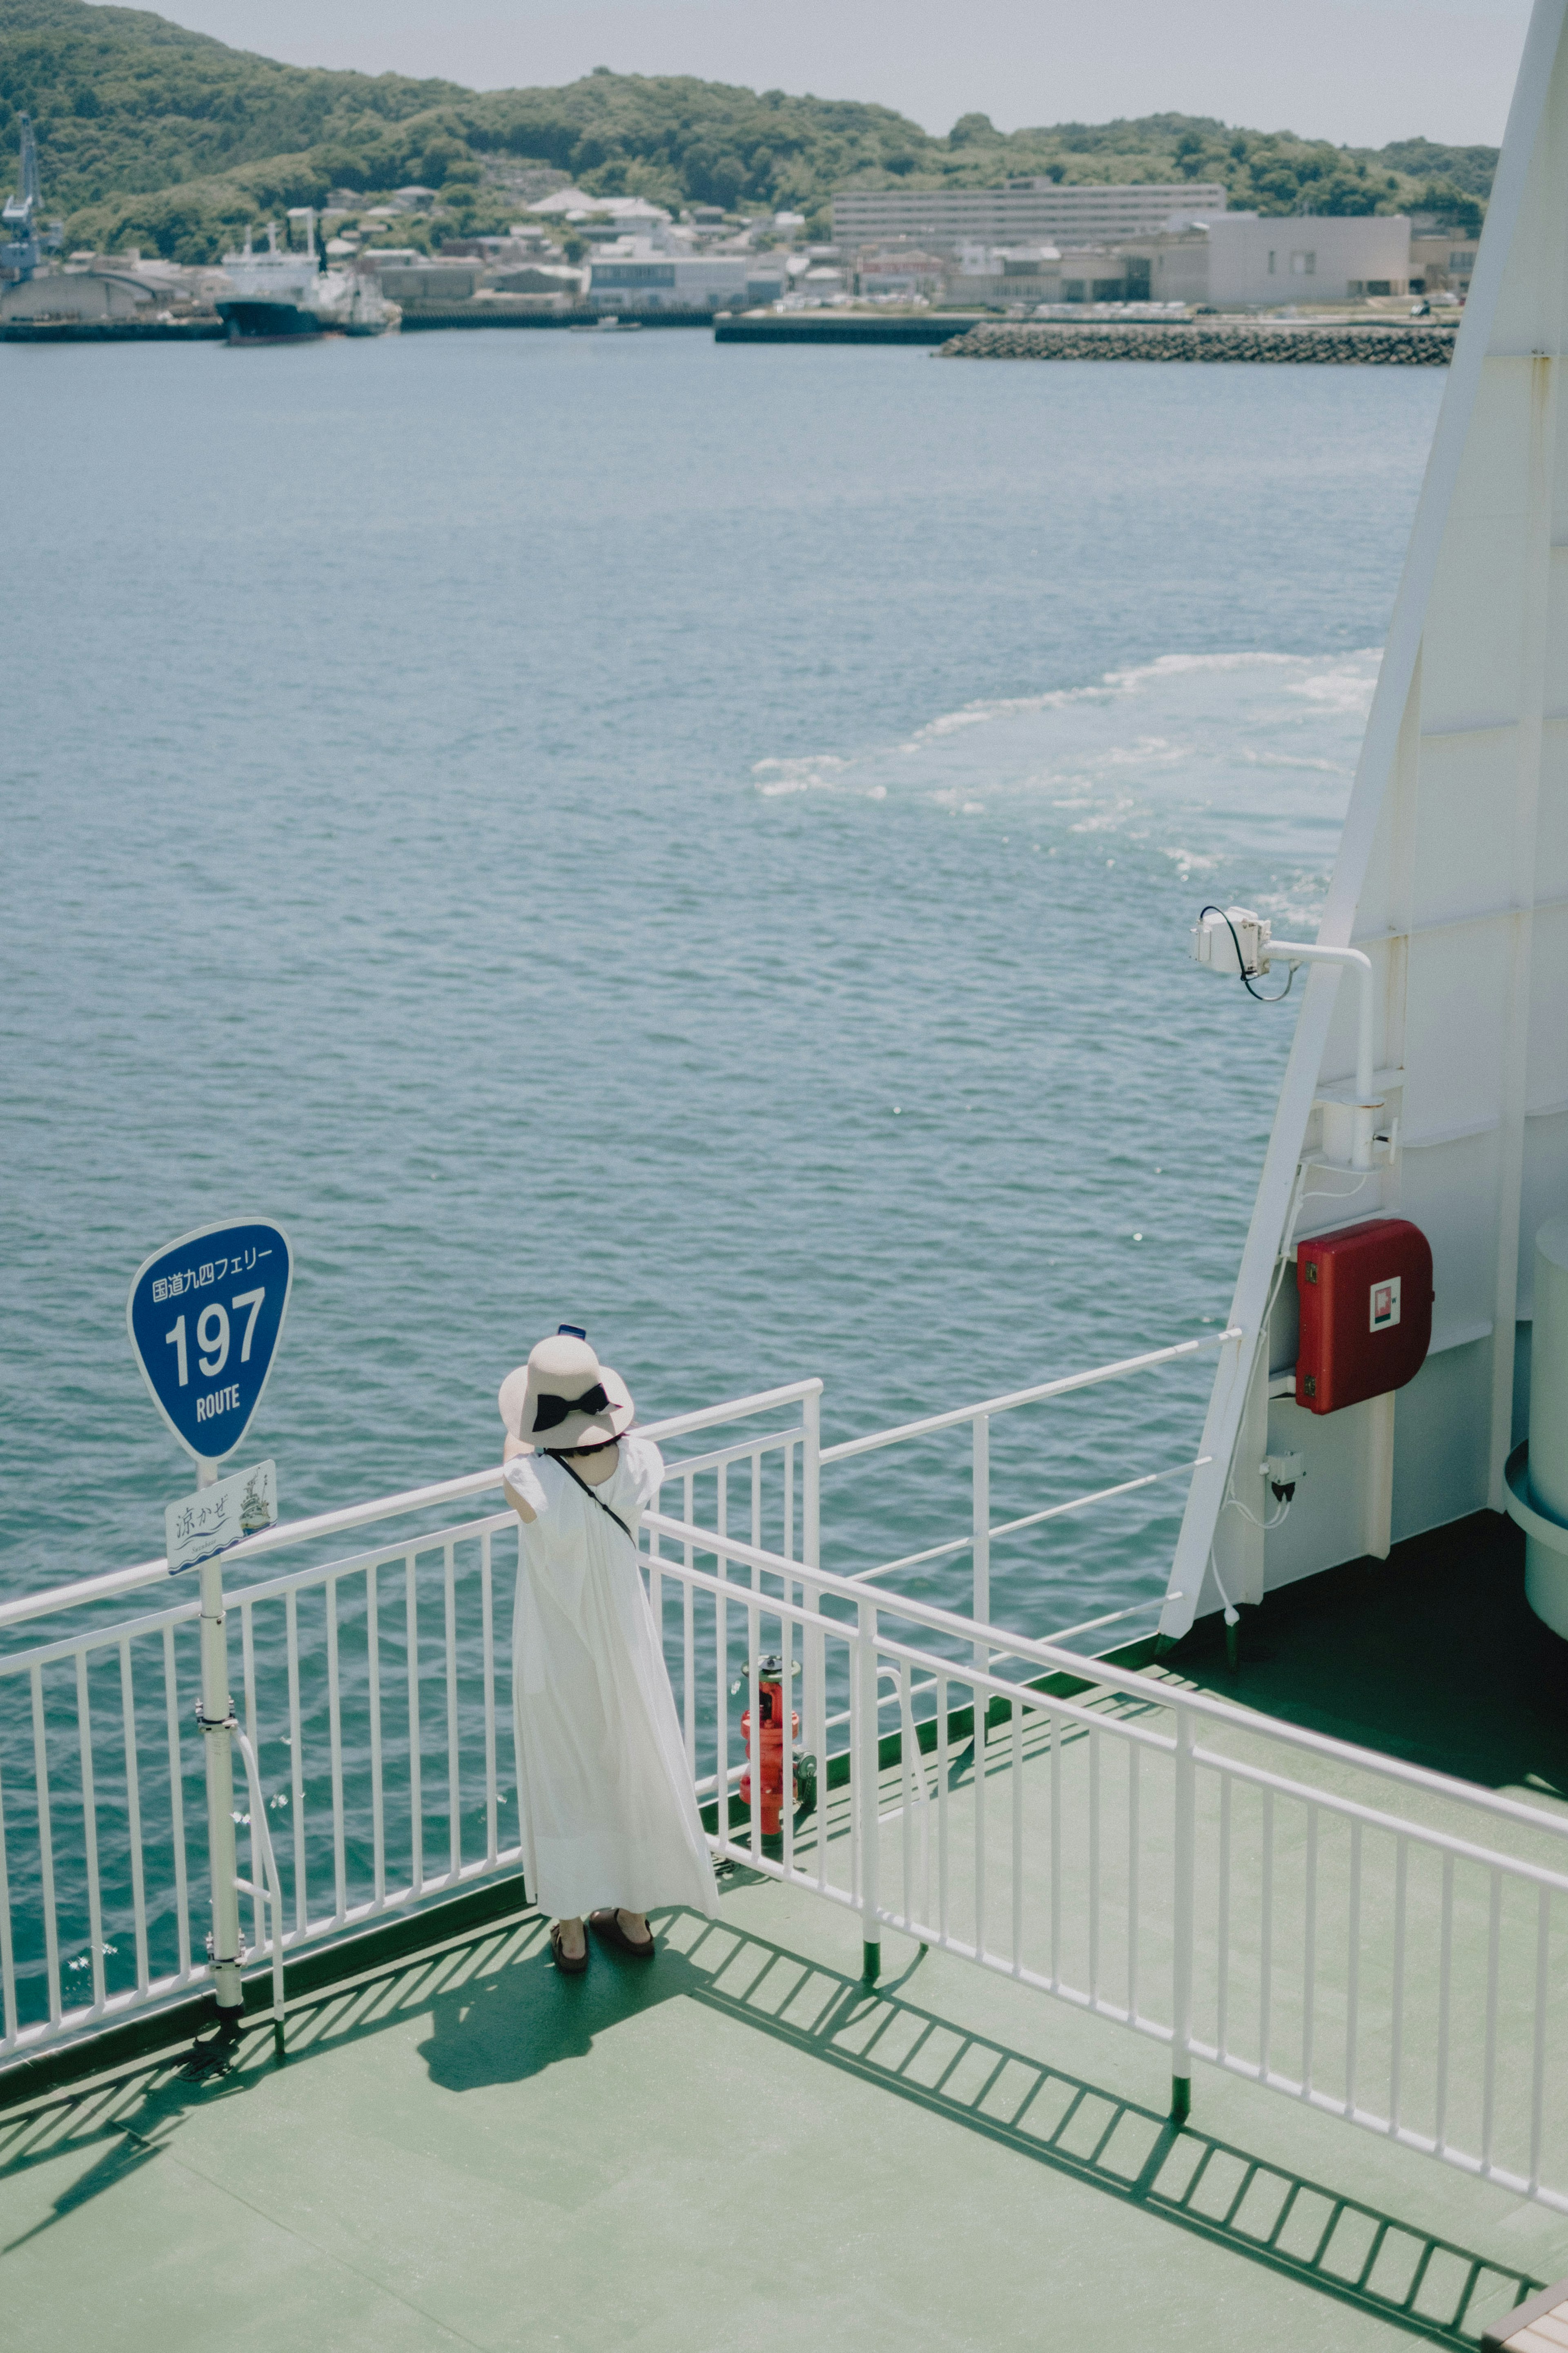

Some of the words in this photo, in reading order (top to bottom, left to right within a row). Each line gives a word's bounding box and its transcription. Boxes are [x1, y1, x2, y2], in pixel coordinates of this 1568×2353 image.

[152, 1247, 272, 1303] 国道九四フェリー
[166, 1287, 265, 1387] 197
[197, 1383, 240, 1422] ROUTE
[176, 1494, 228, 1538] 涼かぜ
